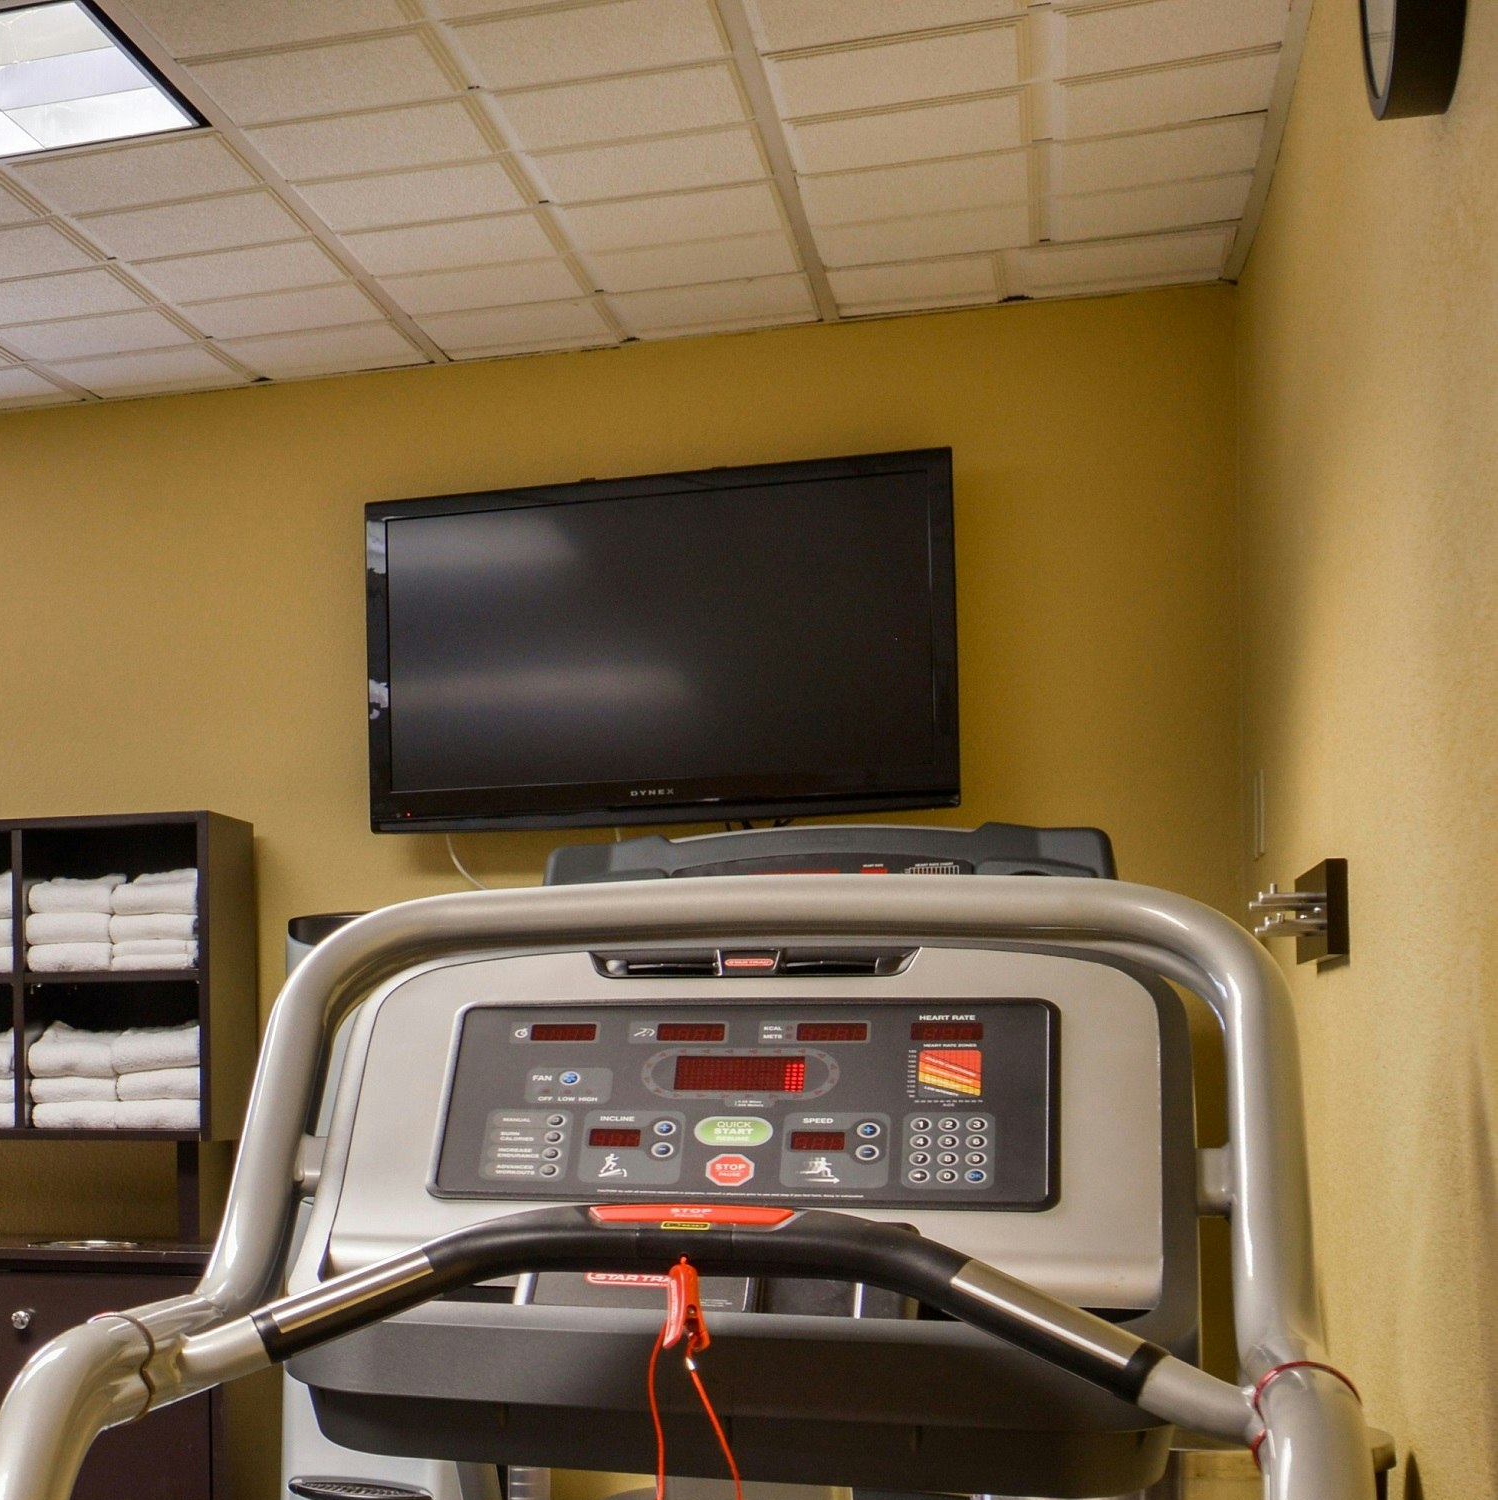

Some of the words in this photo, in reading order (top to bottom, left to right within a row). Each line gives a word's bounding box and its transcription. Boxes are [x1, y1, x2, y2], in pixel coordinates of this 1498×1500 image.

[630, 788, 674, 797] DYNEX
[715, 1163, 746, 1171] STOP
[592, 1273, 639, 1282] STAR
